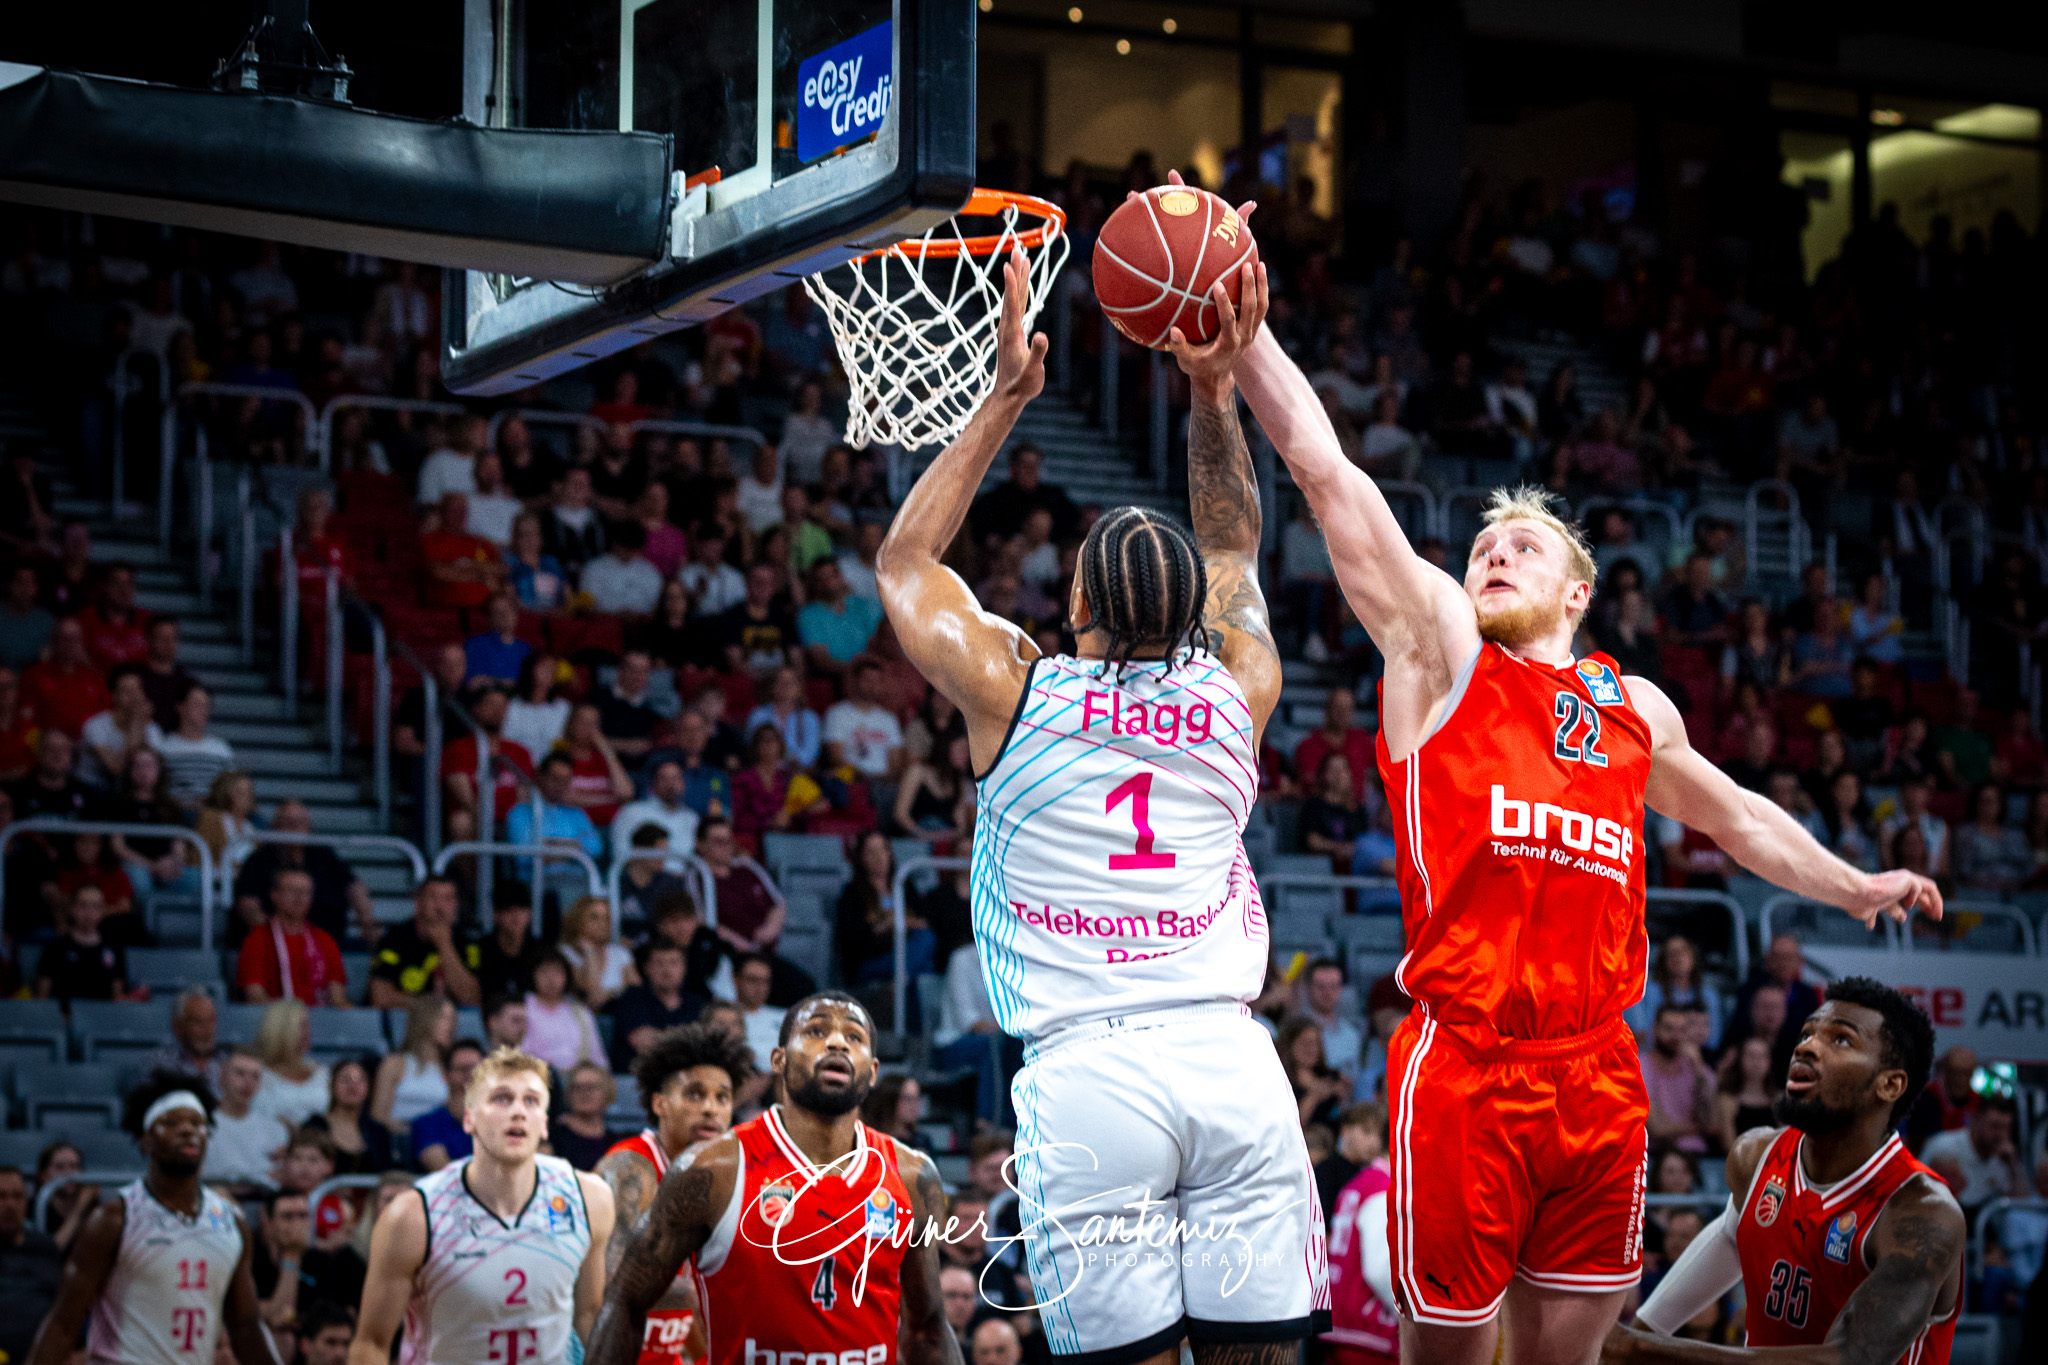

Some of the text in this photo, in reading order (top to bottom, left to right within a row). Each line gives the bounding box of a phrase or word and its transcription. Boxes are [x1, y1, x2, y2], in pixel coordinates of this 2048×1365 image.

[831, 73, 893, 136] Credi
[1081, 689, 1212, 745] Flagg
[1554, 690, 1609, 768] 22
[1105, 772, 1177, 870] 1
[1491, 784, 1633, 868] brose
[1549, 847, 1573, 867] für
[1009, 899, 1150, 937] Telekom
[178, 1258, 208, 1291] 11
[503, 1268, 528, 1306] 2
[812, 1255, 837, 1311] 4
[1764, 1259, 1813, 1329] 35
